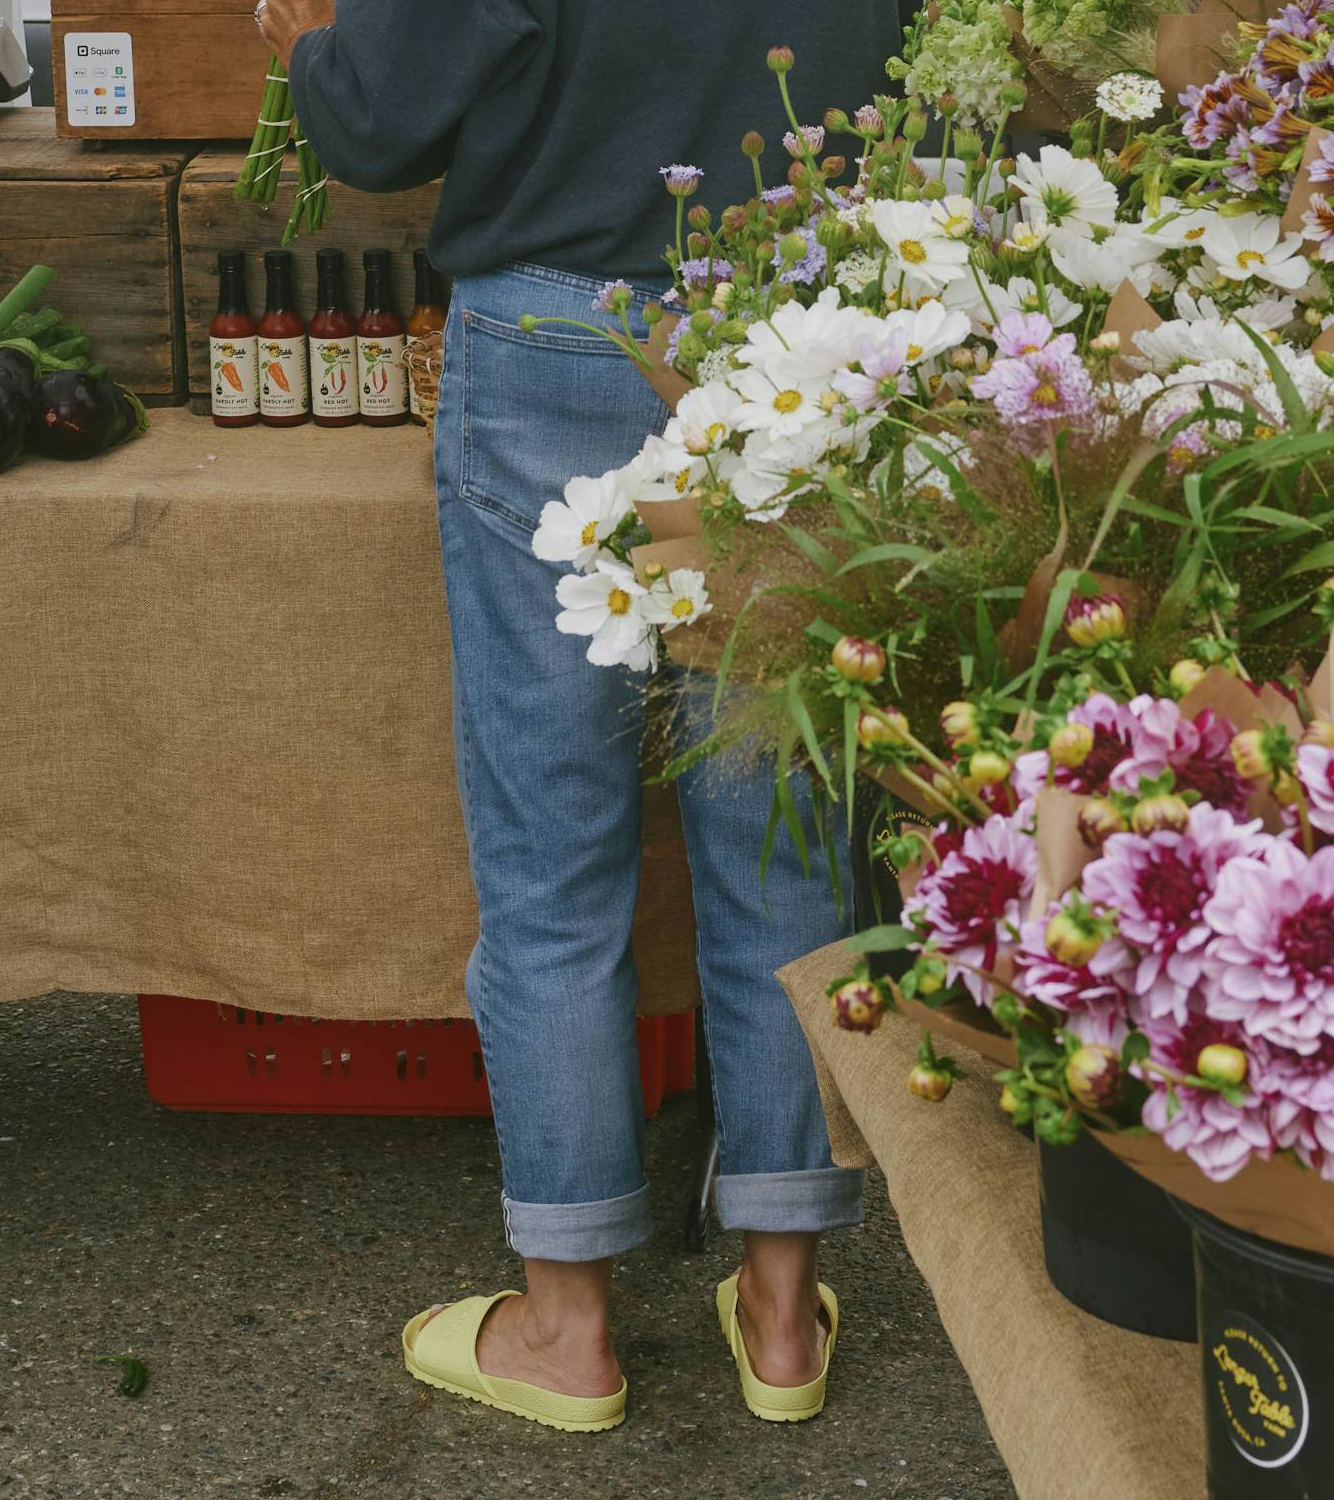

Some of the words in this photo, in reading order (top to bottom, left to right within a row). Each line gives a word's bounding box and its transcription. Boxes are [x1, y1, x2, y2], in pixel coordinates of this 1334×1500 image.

[91, 47, 120, 56] Square
[1213, 1344, 1259, 1390] Longer
[1248, 1389, 1295, 1428] Table
